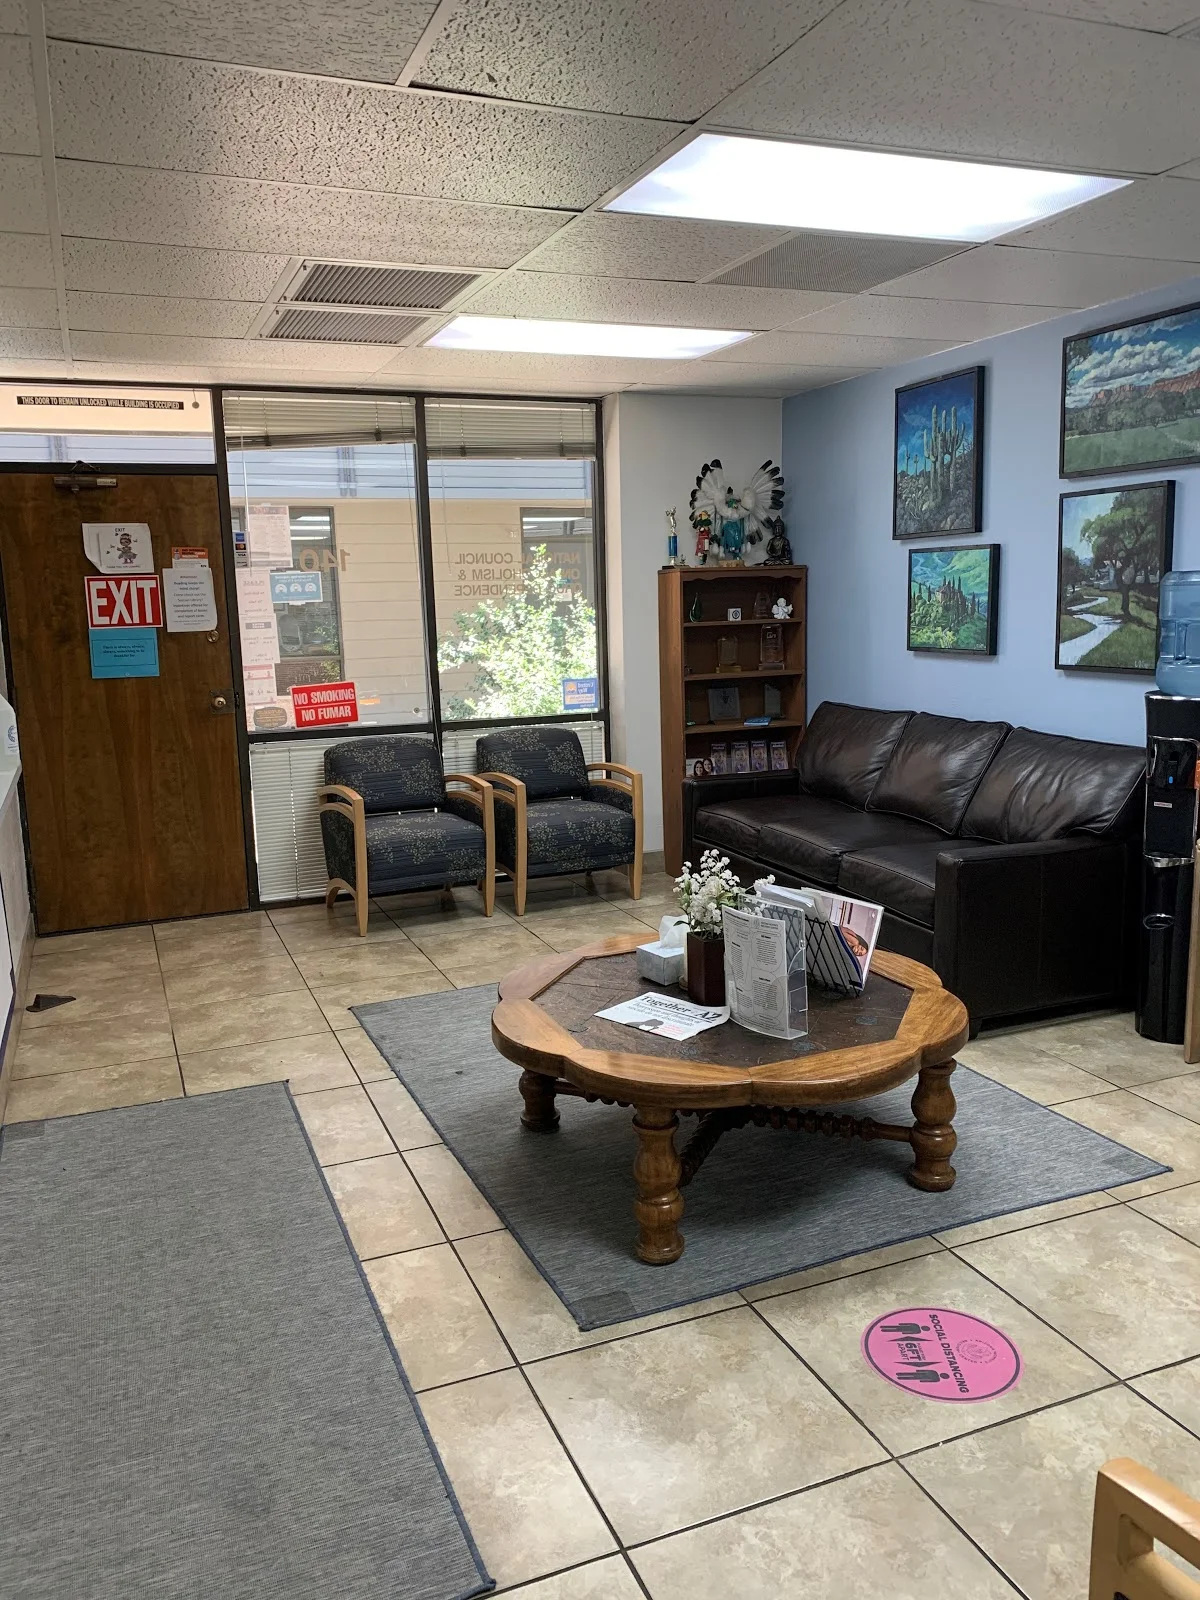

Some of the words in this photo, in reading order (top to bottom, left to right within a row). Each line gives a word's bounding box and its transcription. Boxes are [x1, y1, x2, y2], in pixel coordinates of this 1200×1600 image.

[21, 397, 34, 405] THIS
[34, 397, 50, 405] DOOR
[51, 398, 58, 406] TO
[59, 398, 79, 406] REMAIN
[80, 399, 107, 407] UNLOCKED
[108, 400, 124, 408] WHILE
[125, 401, 148, 409] BUILDING
[155, 402, 180, 410] OCCUPIED
[89, 580, 157, 625] EXIT
[294, 692, 308, 706] NO
[310, 688, 355, 704] SMOKING
[302, 709, 316, 722] NO
[318, 706, 352, 721] FUMAR
[640, 996, 692, 1013] Together
[695, 1011, 723, 1022] AZ
[896, 1342, 910, 1361] APART
[904, 1342, 922, 1362] 6FT
[928, 1314, 948, 1341] SOCIAL
[940, 1342, 970, 1394] DISTANCING
